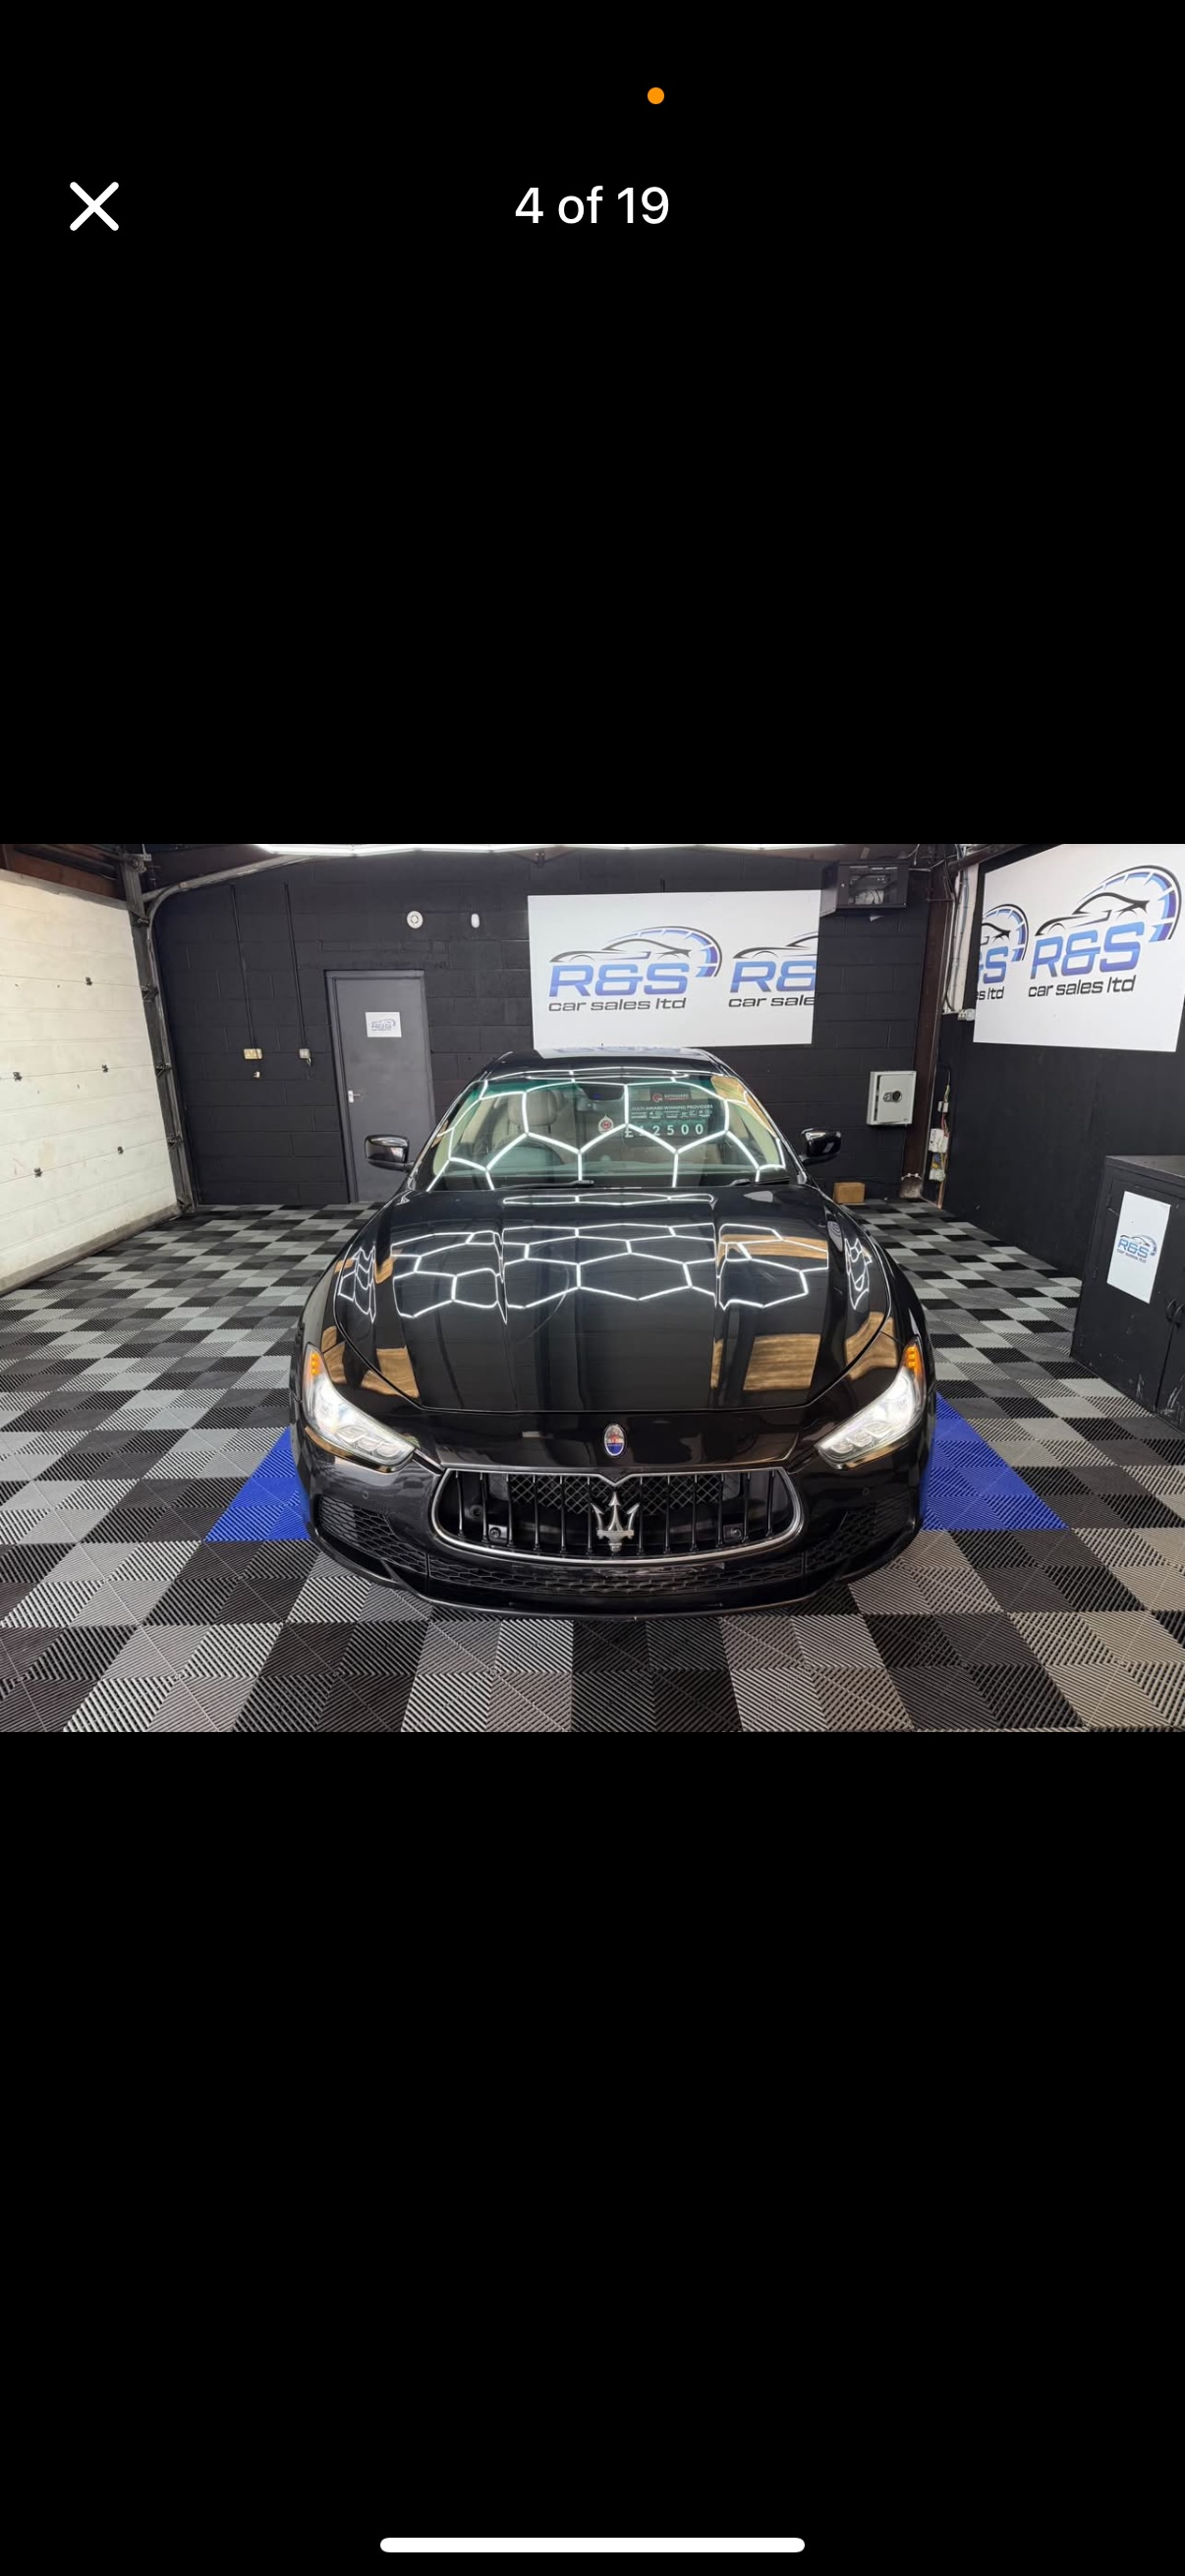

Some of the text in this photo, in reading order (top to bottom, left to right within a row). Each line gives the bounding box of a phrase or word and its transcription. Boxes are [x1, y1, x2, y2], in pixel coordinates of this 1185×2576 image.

[1030, 921, 1145, 980] R&S
[548, 962, 690, 997] R&S
[1028, 975, 1136, 998] car sales ltd
[728, 998, 766, 1008] car
[987, 986, 1004, 1000] ltd
[548, 997, 686, 1012] car sales ltd
[1118, 1238, 1149, 1259] R&S
